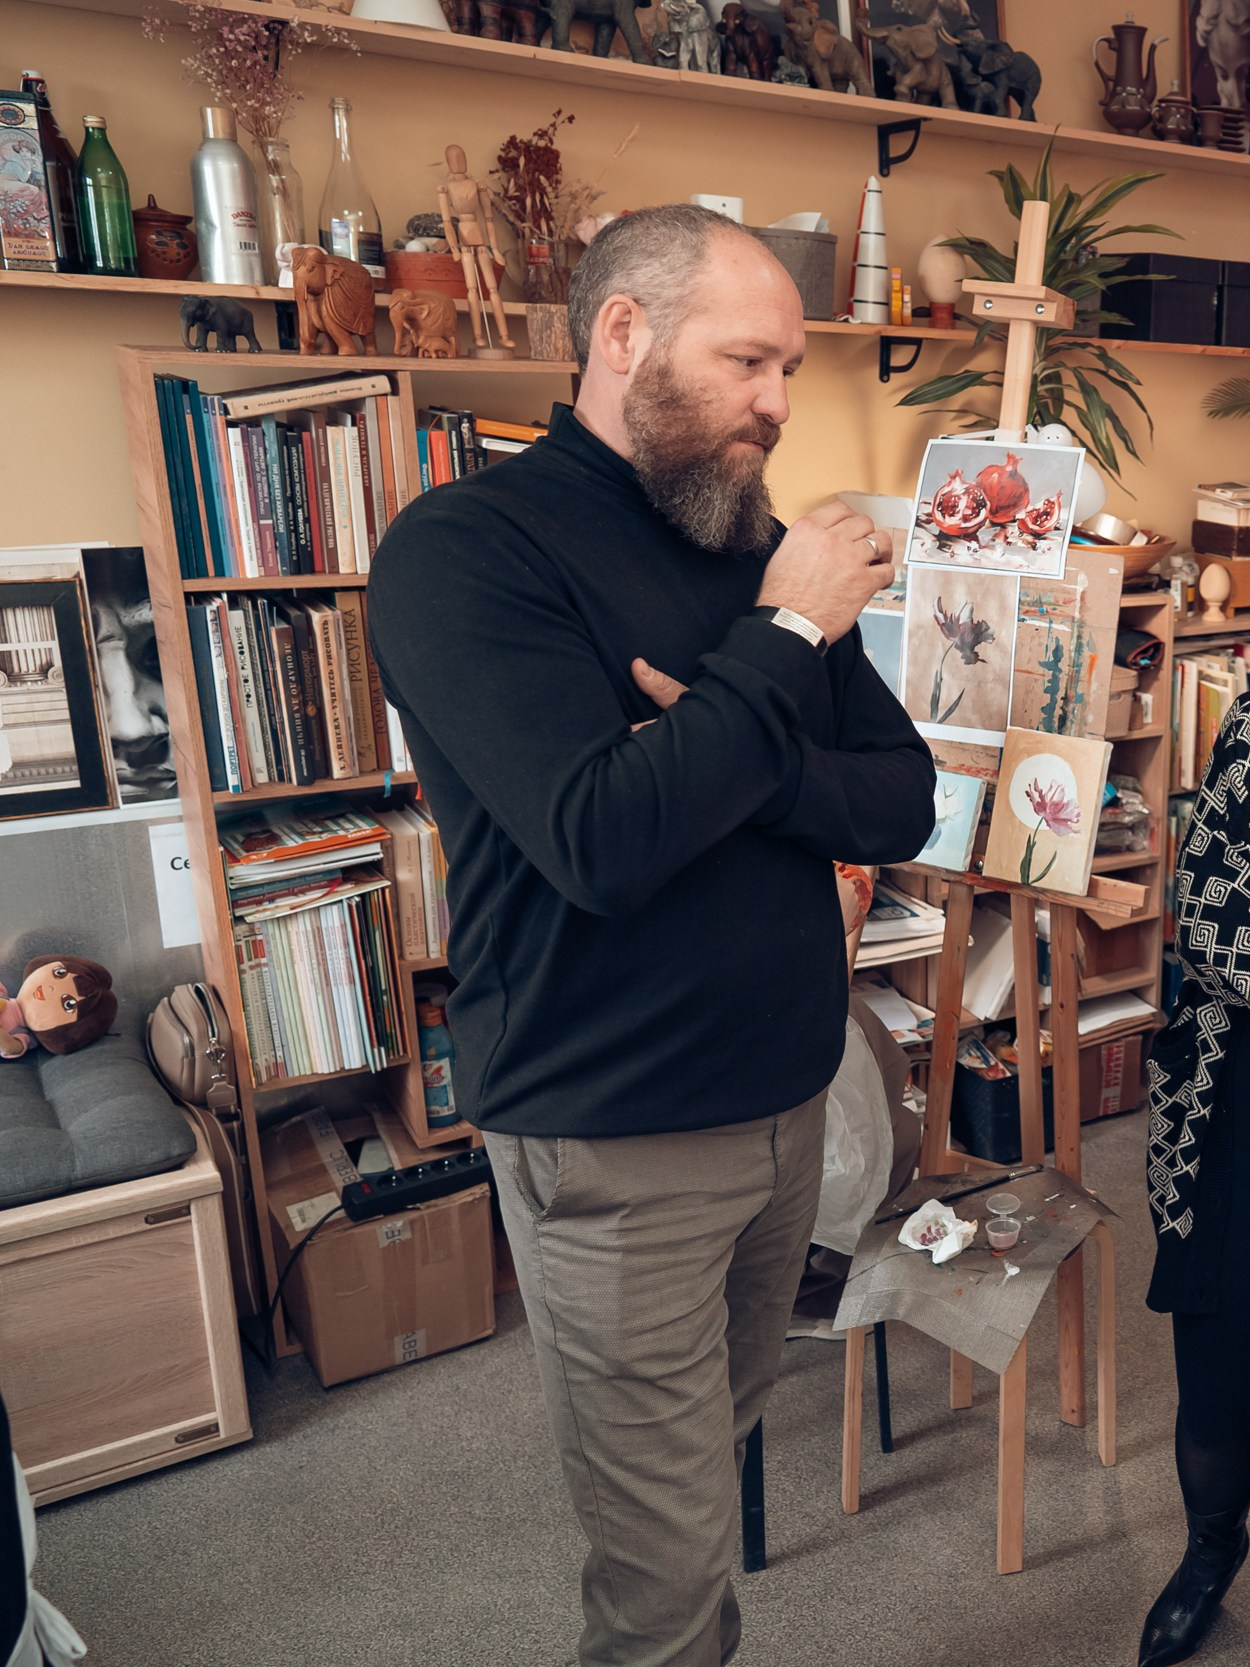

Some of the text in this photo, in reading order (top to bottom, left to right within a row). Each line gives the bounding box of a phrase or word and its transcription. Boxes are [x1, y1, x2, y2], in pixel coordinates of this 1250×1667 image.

[234, 625, 254, 708] ПРОСТОЕ РИСОВАНИЕ
[321, 619, 333, 666] РИСОВАТЬ
[343, 608, 363, 682] РИСУНКА
[283, 642, 297, 695] ЛЕОНАРДО
[301, 649, 313, 701] Натюрморт
[327, 668, 338, 710] УЧИТЕСЬ
[371, 687, 386, 735] ГОЛОВА
[227, 745, 238, 775] ПОРТРЕТ
[170, 856, 191, 871] Се
